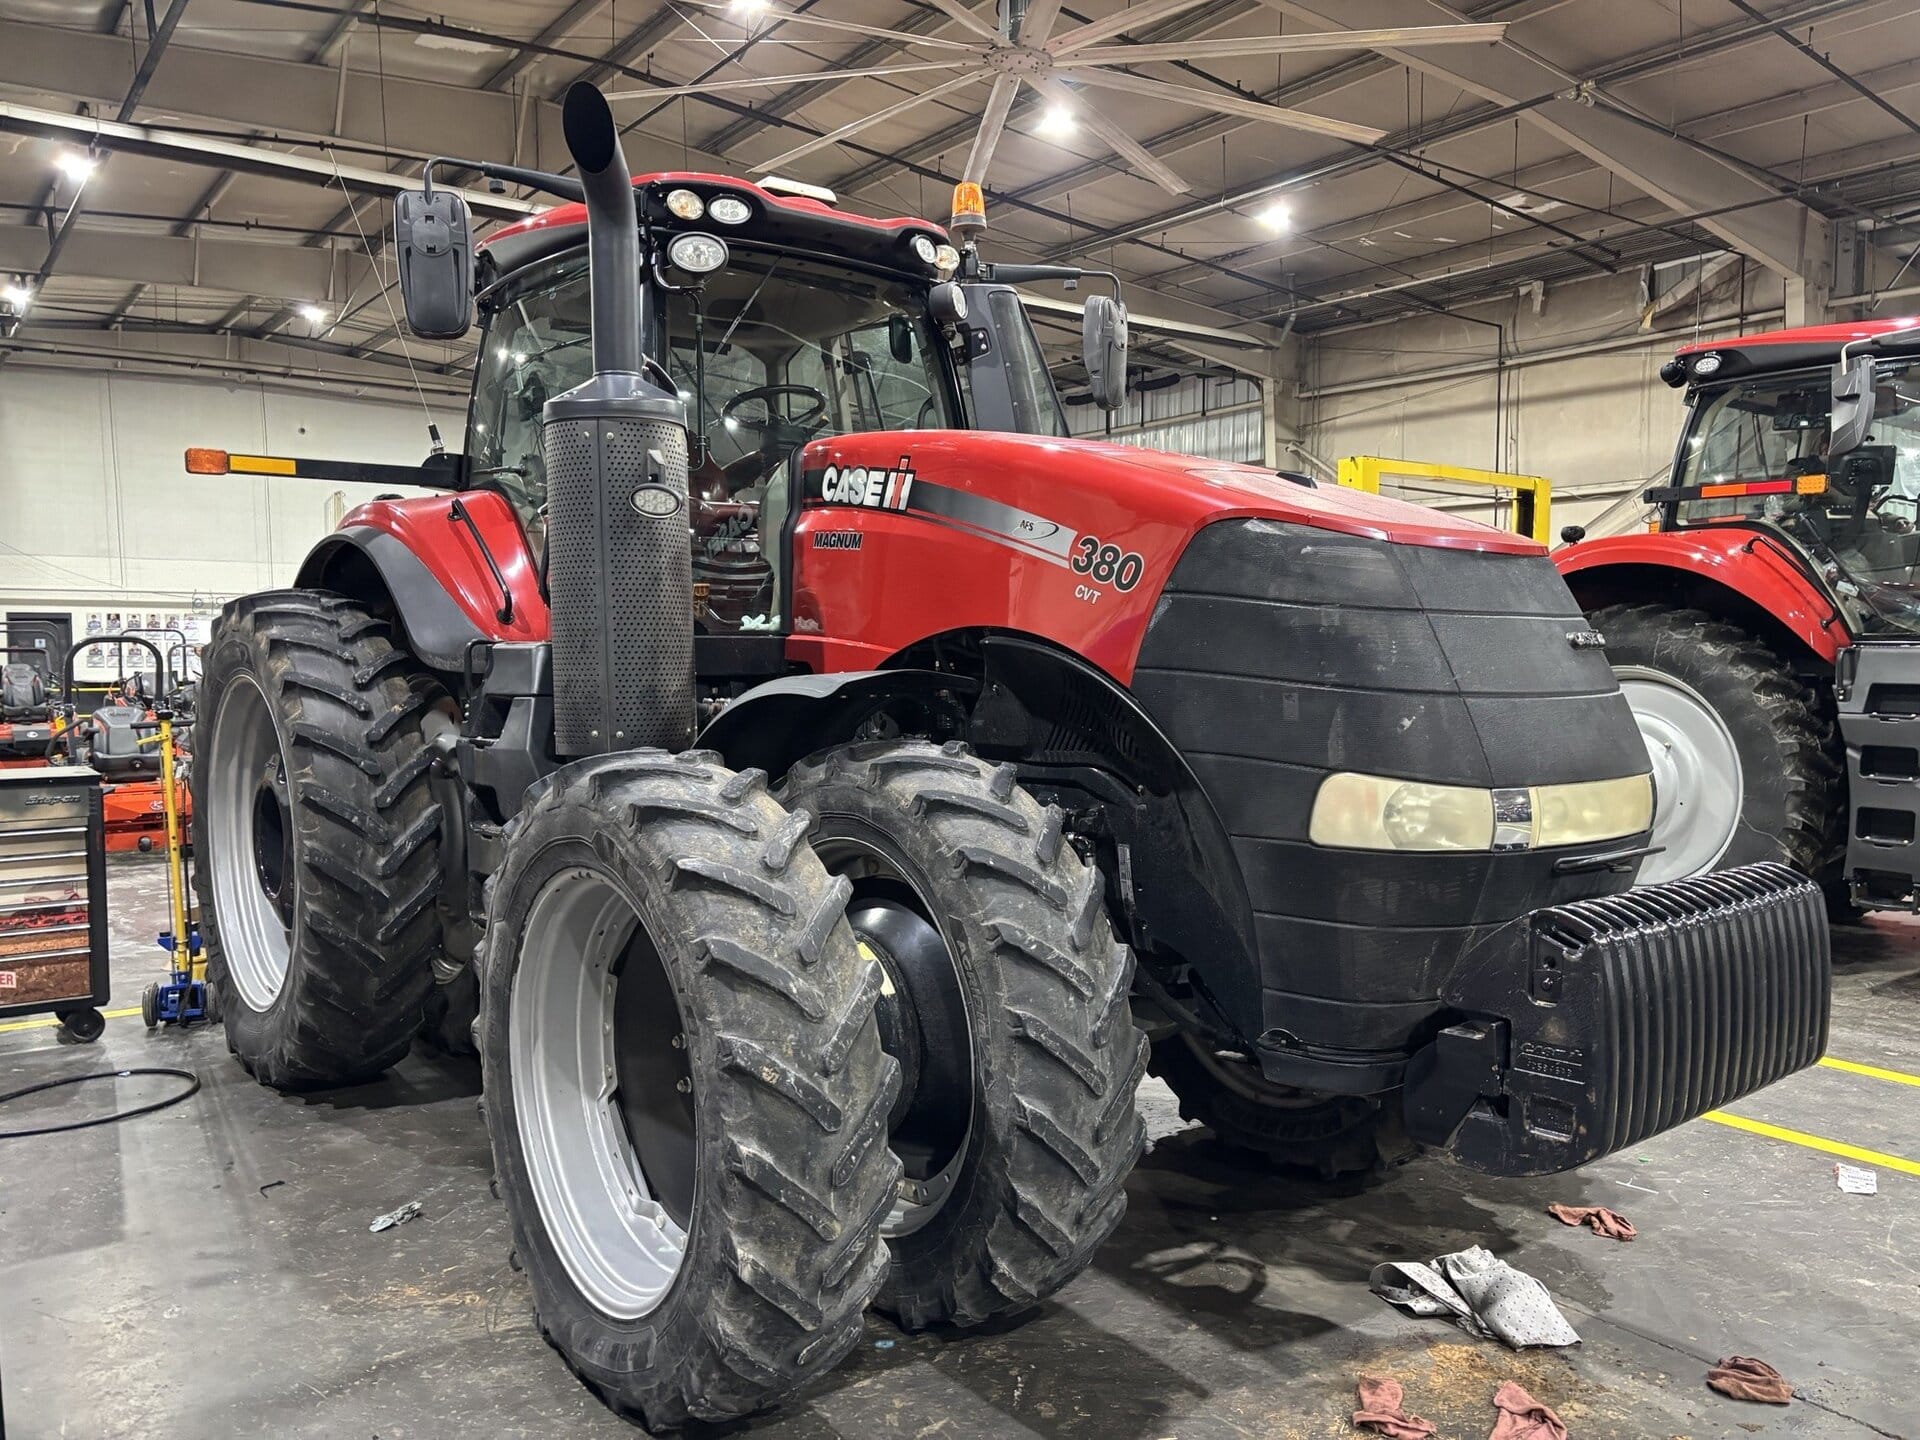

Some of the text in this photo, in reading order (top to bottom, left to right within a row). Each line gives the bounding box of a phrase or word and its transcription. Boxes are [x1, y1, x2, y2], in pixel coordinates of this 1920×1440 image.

[1020, 519, 1034, 532] AFS
[813, 531, 863, 550] MAGNUM
[1071, 535, 1145, 593] 380
[1074, 584, 1102, 605] CVT
